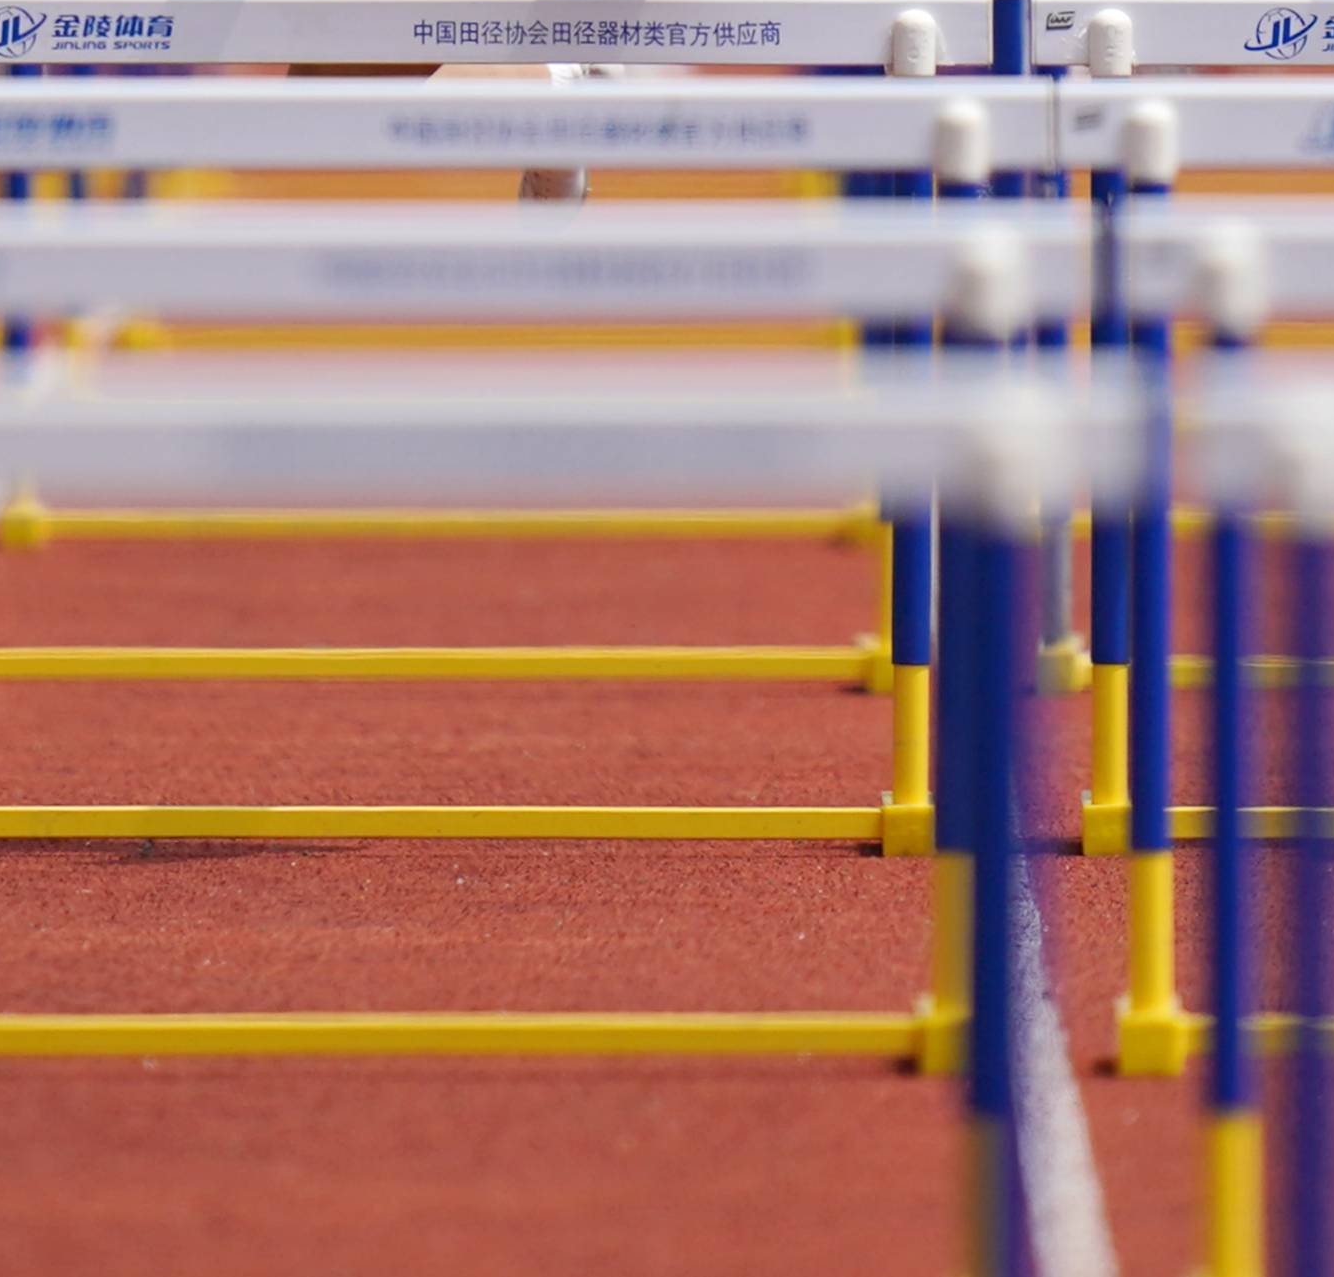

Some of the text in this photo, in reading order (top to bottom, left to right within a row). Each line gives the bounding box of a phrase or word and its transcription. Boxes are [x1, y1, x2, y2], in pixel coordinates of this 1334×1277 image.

[52, 14, 174, 38] 金陵体育
[413, 19, 781, 47] 中国田径协会田径器材类官方供应商
[52, 40, 171, 50] JINLING SPORTS
